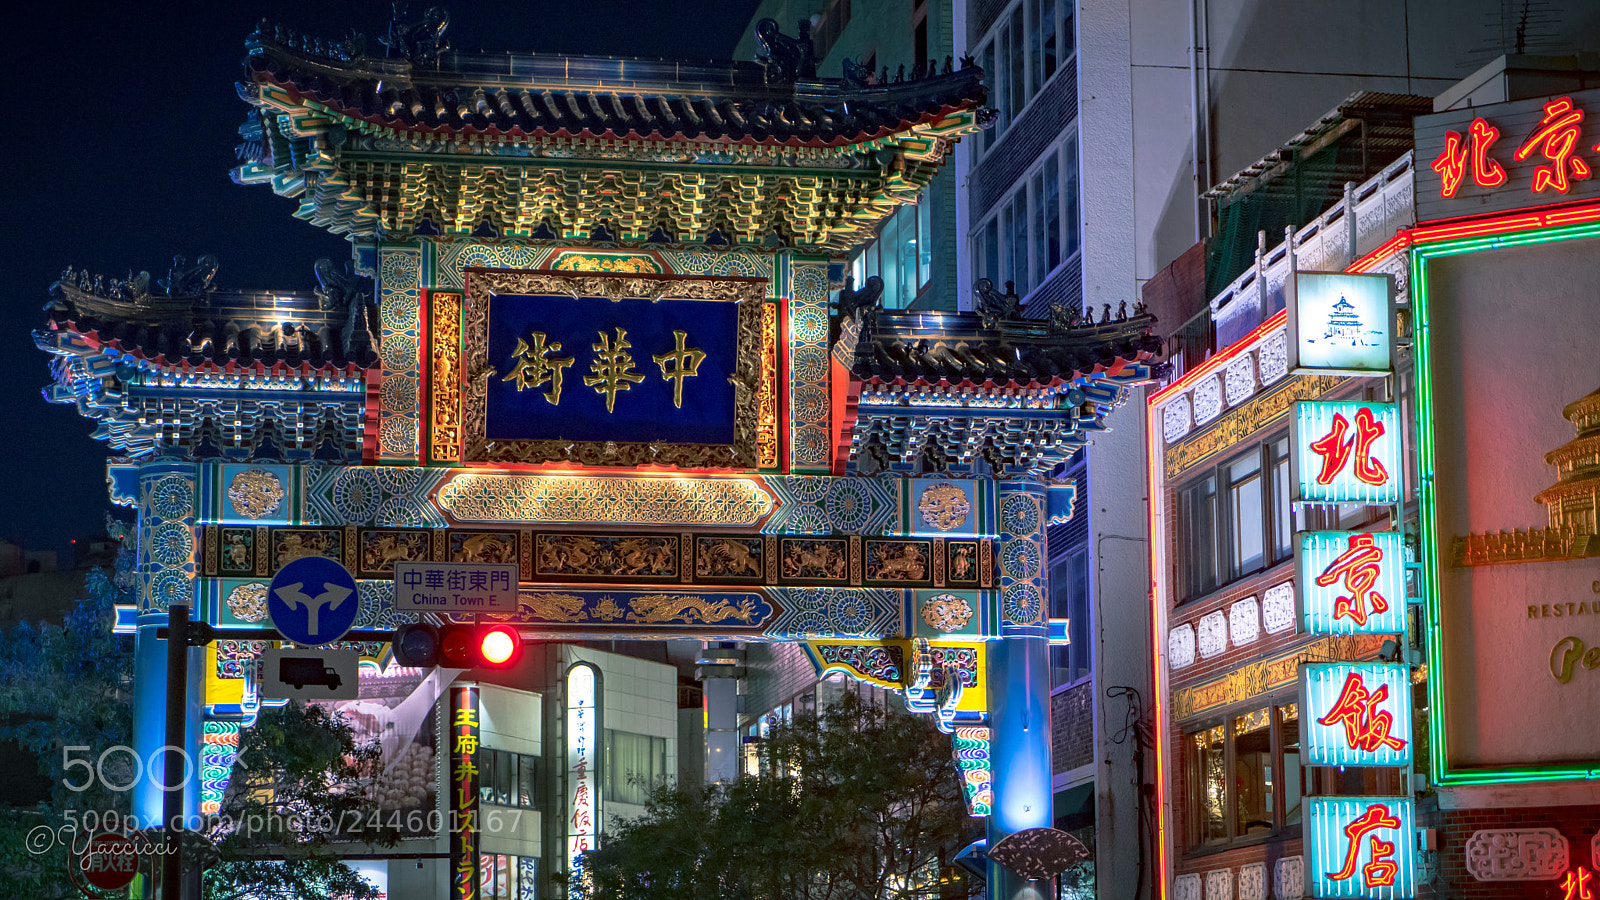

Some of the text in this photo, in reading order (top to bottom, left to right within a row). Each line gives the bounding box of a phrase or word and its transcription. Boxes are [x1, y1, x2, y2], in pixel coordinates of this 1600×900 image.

[1431, 96, 1600, 199] 北京
[501, 327, 707, 414] 中華街
[403, 568, 510, 592] 中華街東門
[412, 593, 447, 606] China
[452, 594, 484, 606] Town
[1310, 406, 1408, 888] 北京飯店
[453, 708, 480, 900] 王府井レストラン
[570, 757, 592, 853] 重慶飯店
